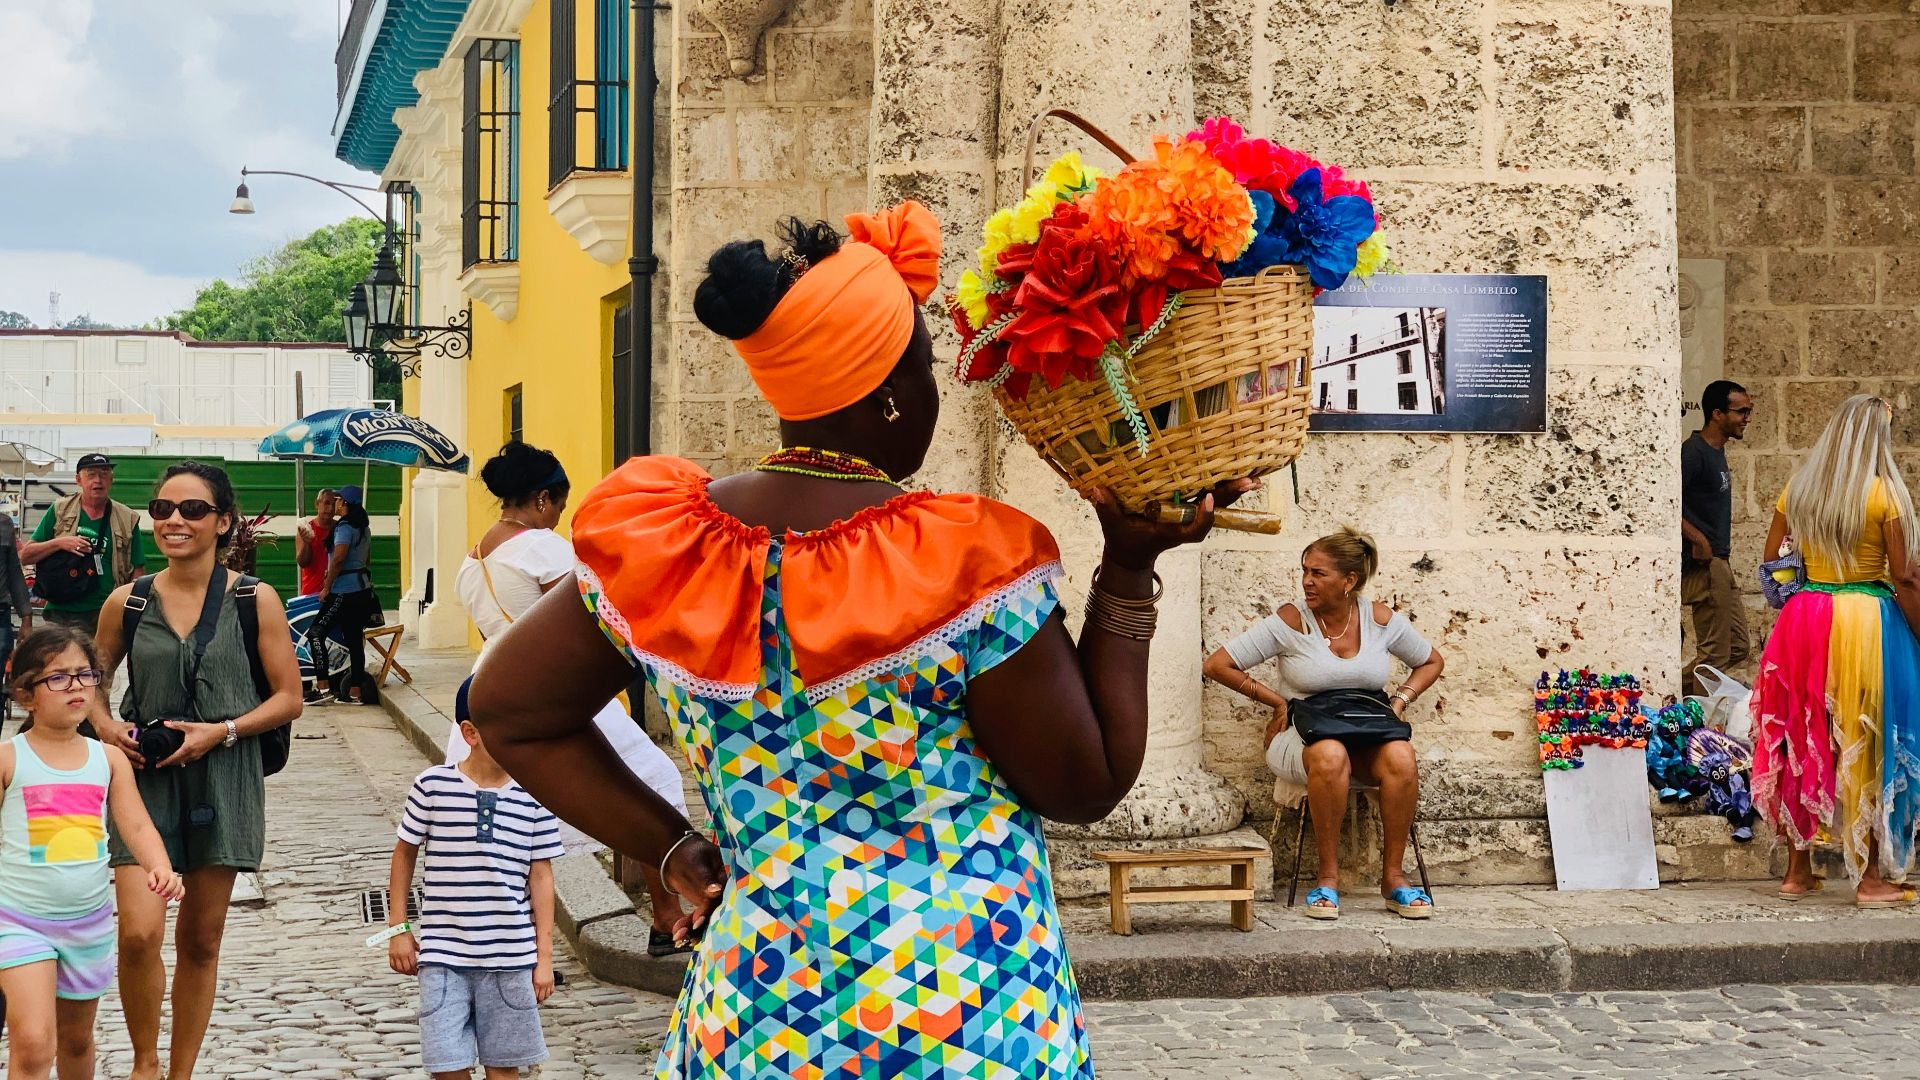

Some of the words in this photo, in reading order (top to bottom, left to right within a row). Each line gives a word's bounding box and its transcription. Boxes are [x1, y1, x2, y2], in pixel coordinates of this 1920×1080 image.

[1349, 285, 1367, 293] DE
[1371, 283, 1411, 293] CONDE
[1432, 283, 1460, 294] CASA
[1463, 283, 1518, 295] LOMBILLO
